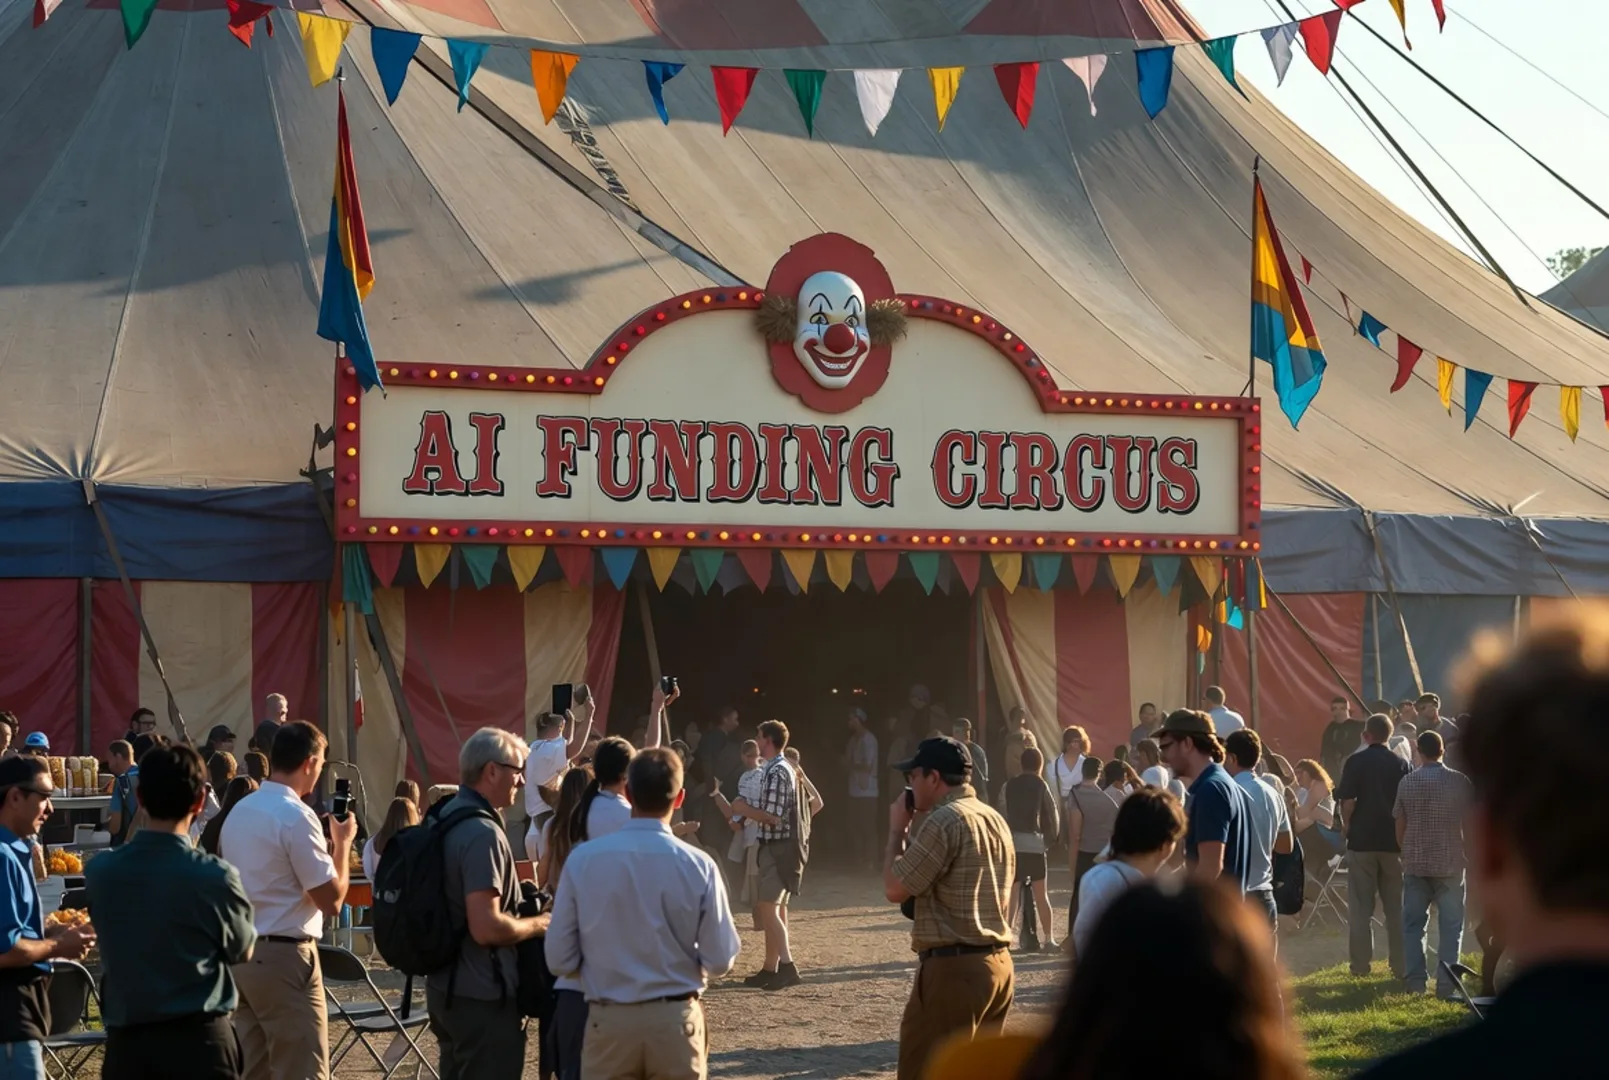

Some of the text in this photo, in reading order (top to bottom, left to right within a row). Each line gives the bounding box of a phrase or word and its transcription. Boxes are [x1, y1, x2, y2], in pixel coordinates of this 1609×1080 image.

[402, 410, 1200, 514] AI FUNDING CIRCUS
